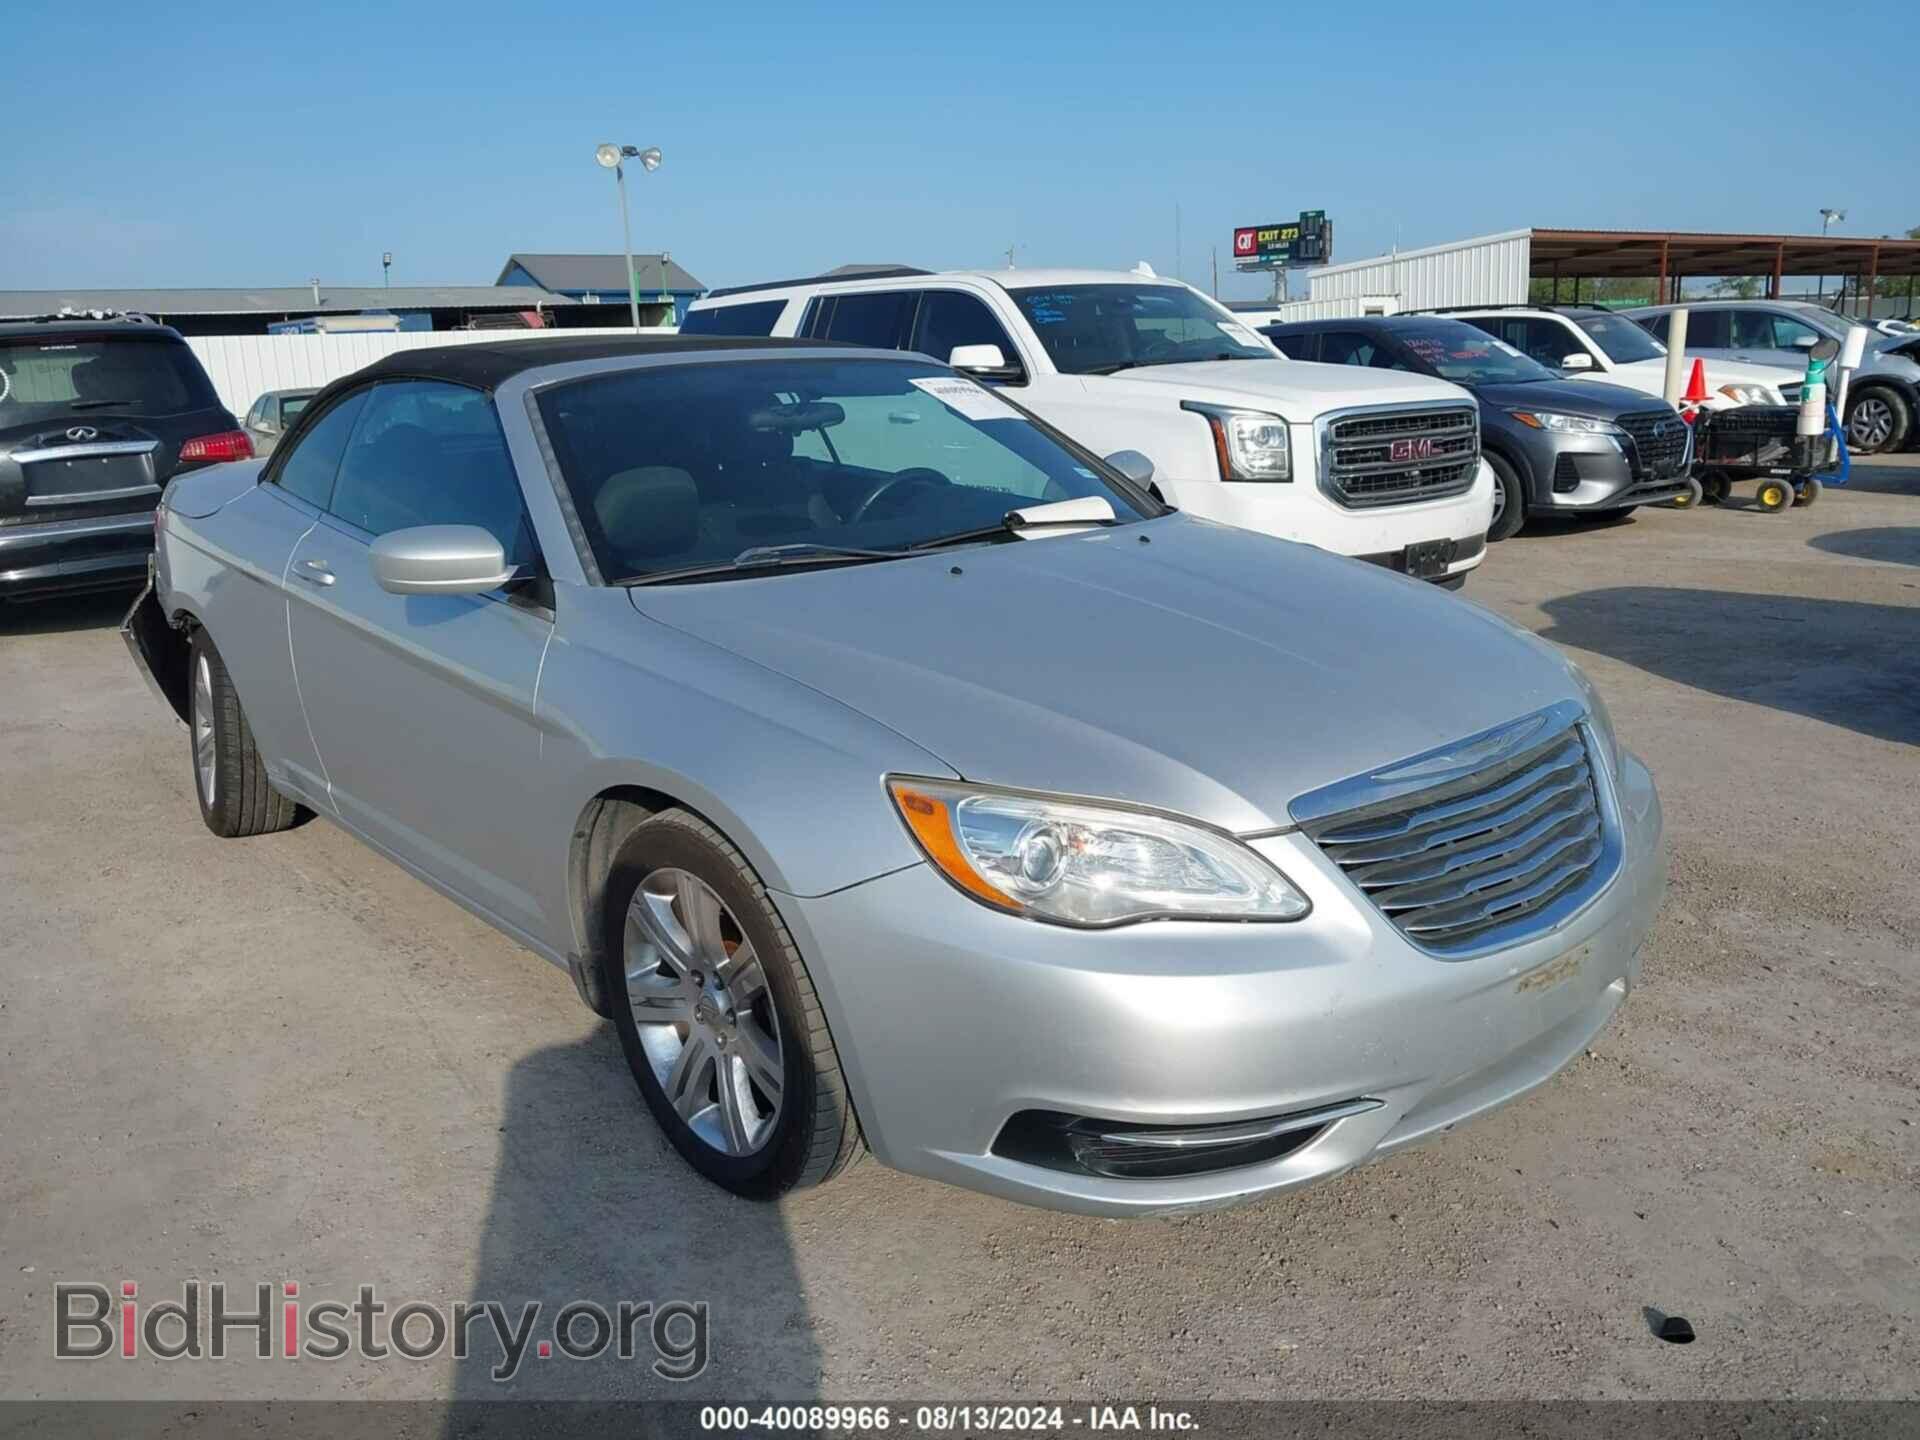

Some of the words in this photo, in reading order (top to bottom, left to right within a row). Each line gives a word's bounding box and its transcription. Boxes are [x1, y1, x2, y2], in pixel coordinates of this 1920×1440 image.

[1238, 233, 1253, 249] QT
[1258, 230, 1279, 241] EXIT
[1281, 228, 1298, 239] 273
